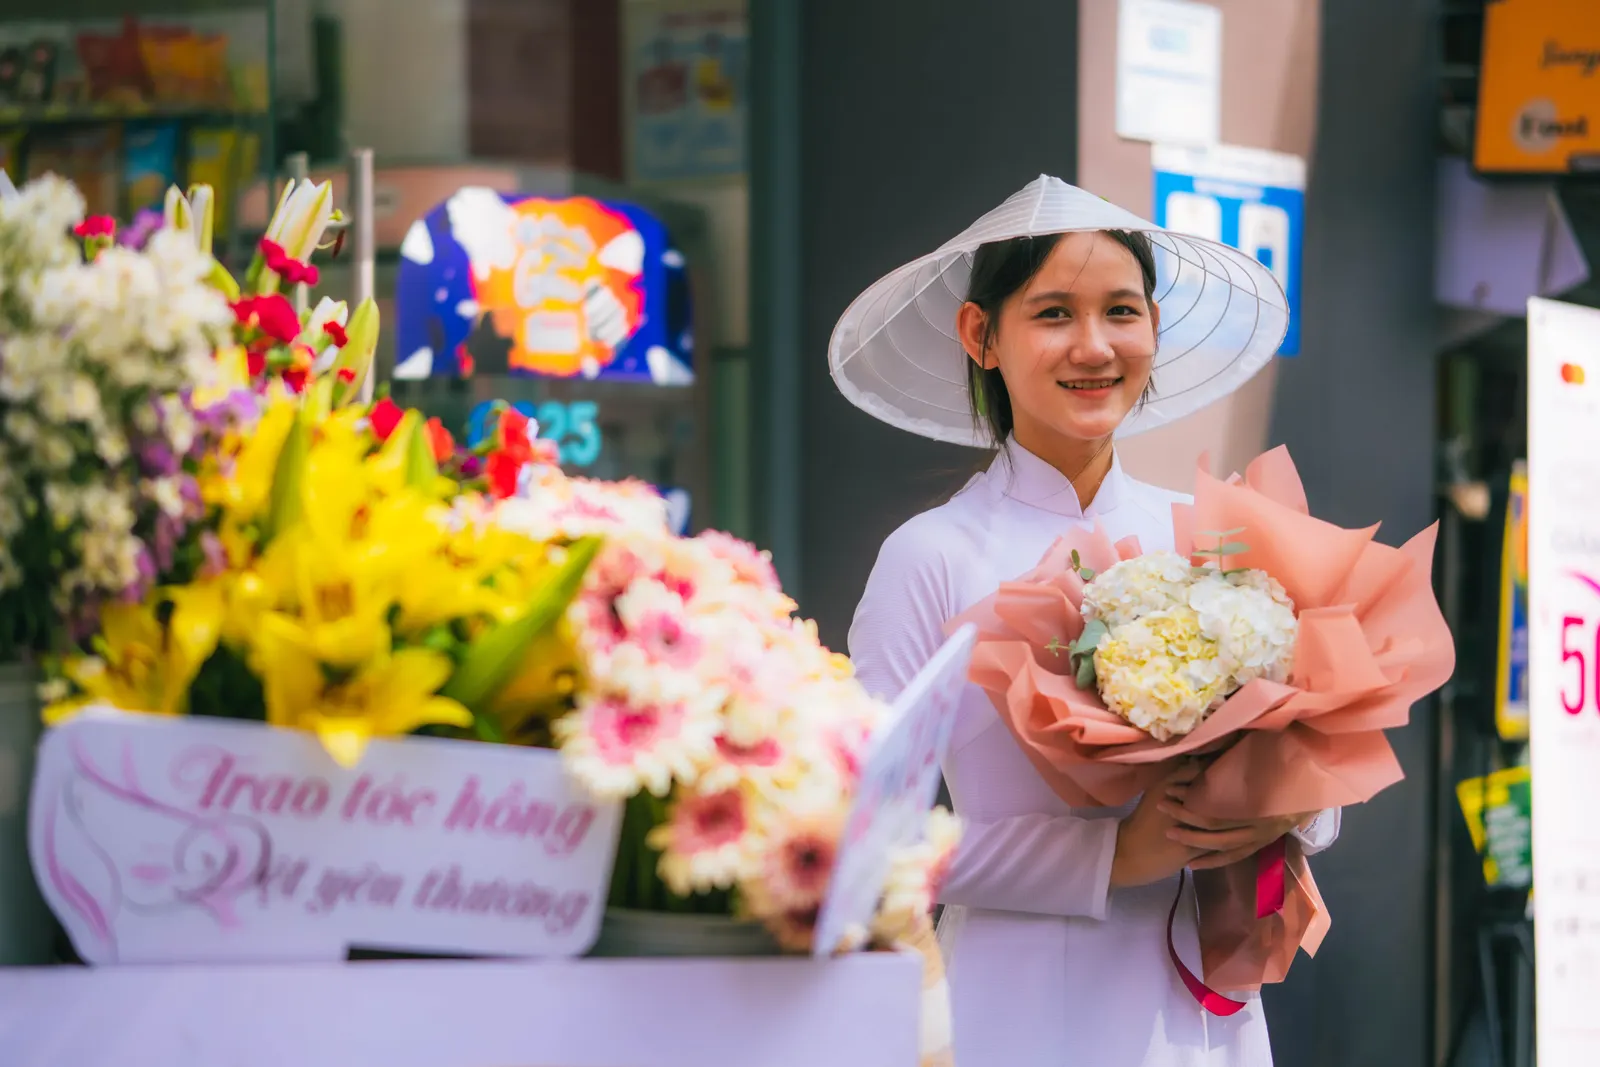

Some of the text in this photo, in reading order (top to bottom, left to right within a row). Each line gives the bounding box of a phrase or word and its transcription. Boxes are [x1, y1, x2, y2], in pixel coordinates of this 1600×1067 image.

[467, 400, 600, 466] 25
[1561, 614, 1600, 716] 5
[169, 746, 332, 818] Trao
